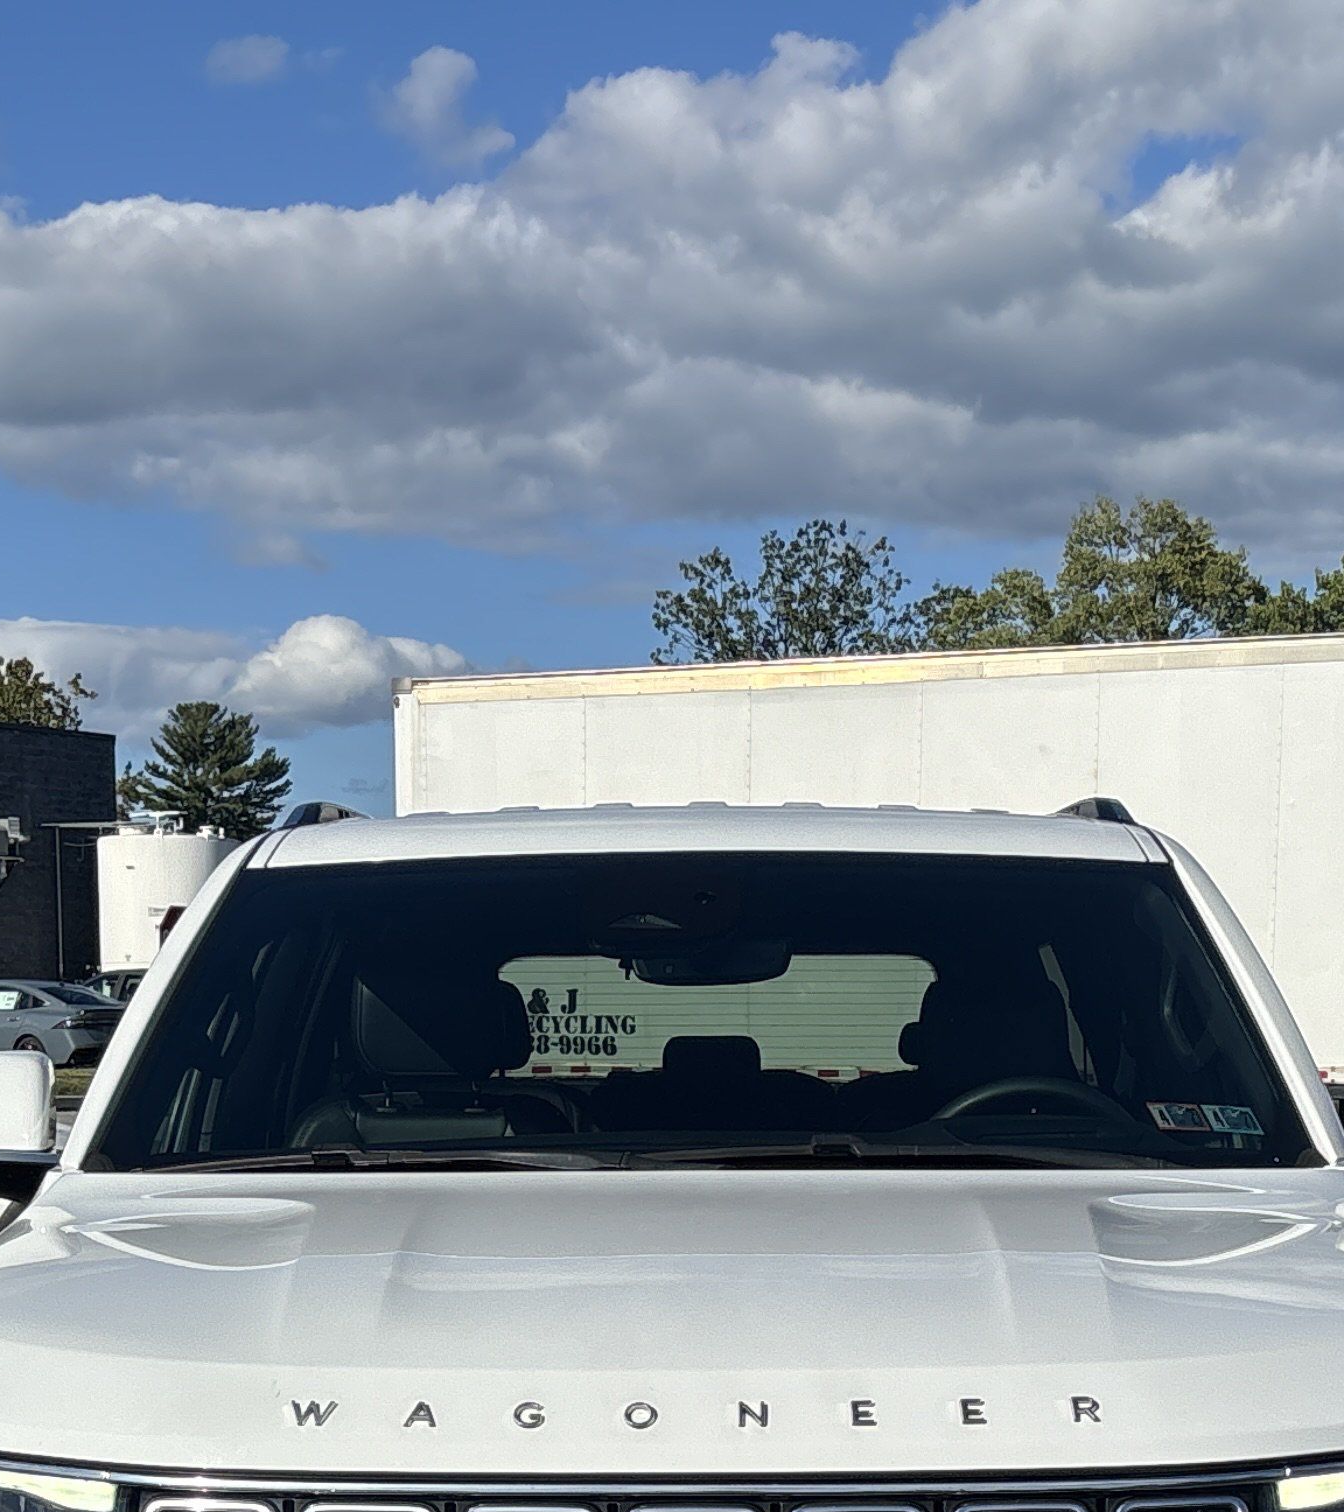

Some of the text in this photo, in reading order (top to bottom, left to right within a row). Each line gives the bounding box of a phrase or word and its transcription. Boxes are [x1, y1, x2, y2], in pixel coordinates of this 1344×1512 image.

[527, 988, 578, 1014] & J
[290, 1396, 1102, 1429] WAGONEER
